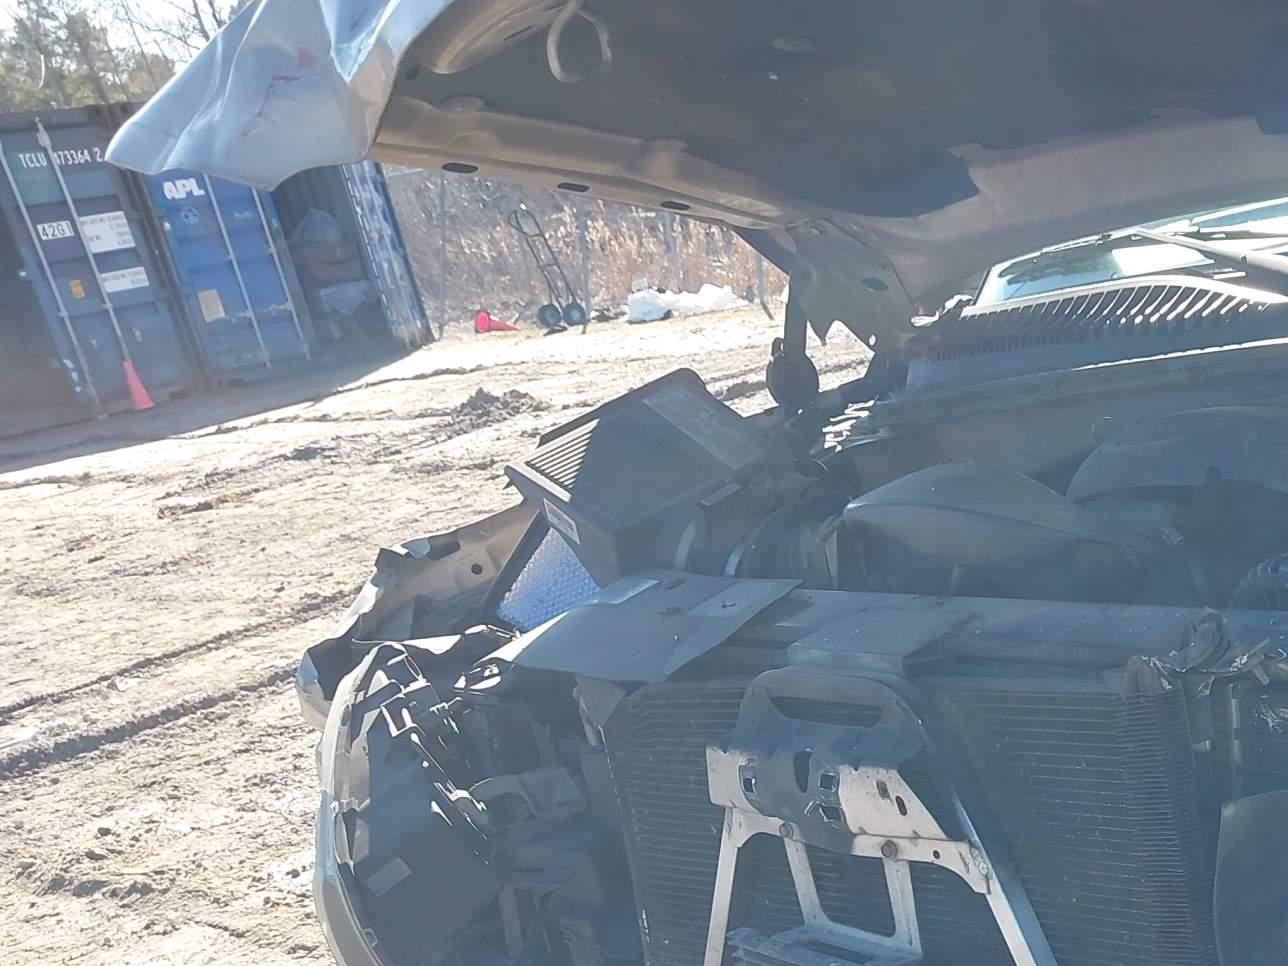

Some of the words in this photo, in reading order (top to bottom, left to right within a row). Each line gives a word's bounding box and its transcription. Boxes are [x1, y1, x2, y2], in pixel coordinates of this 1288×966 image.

[18, 152, 47, 168] TCLU
[163, 178, 205, 199] APL
[41, 222, 73, 239] 42G1
